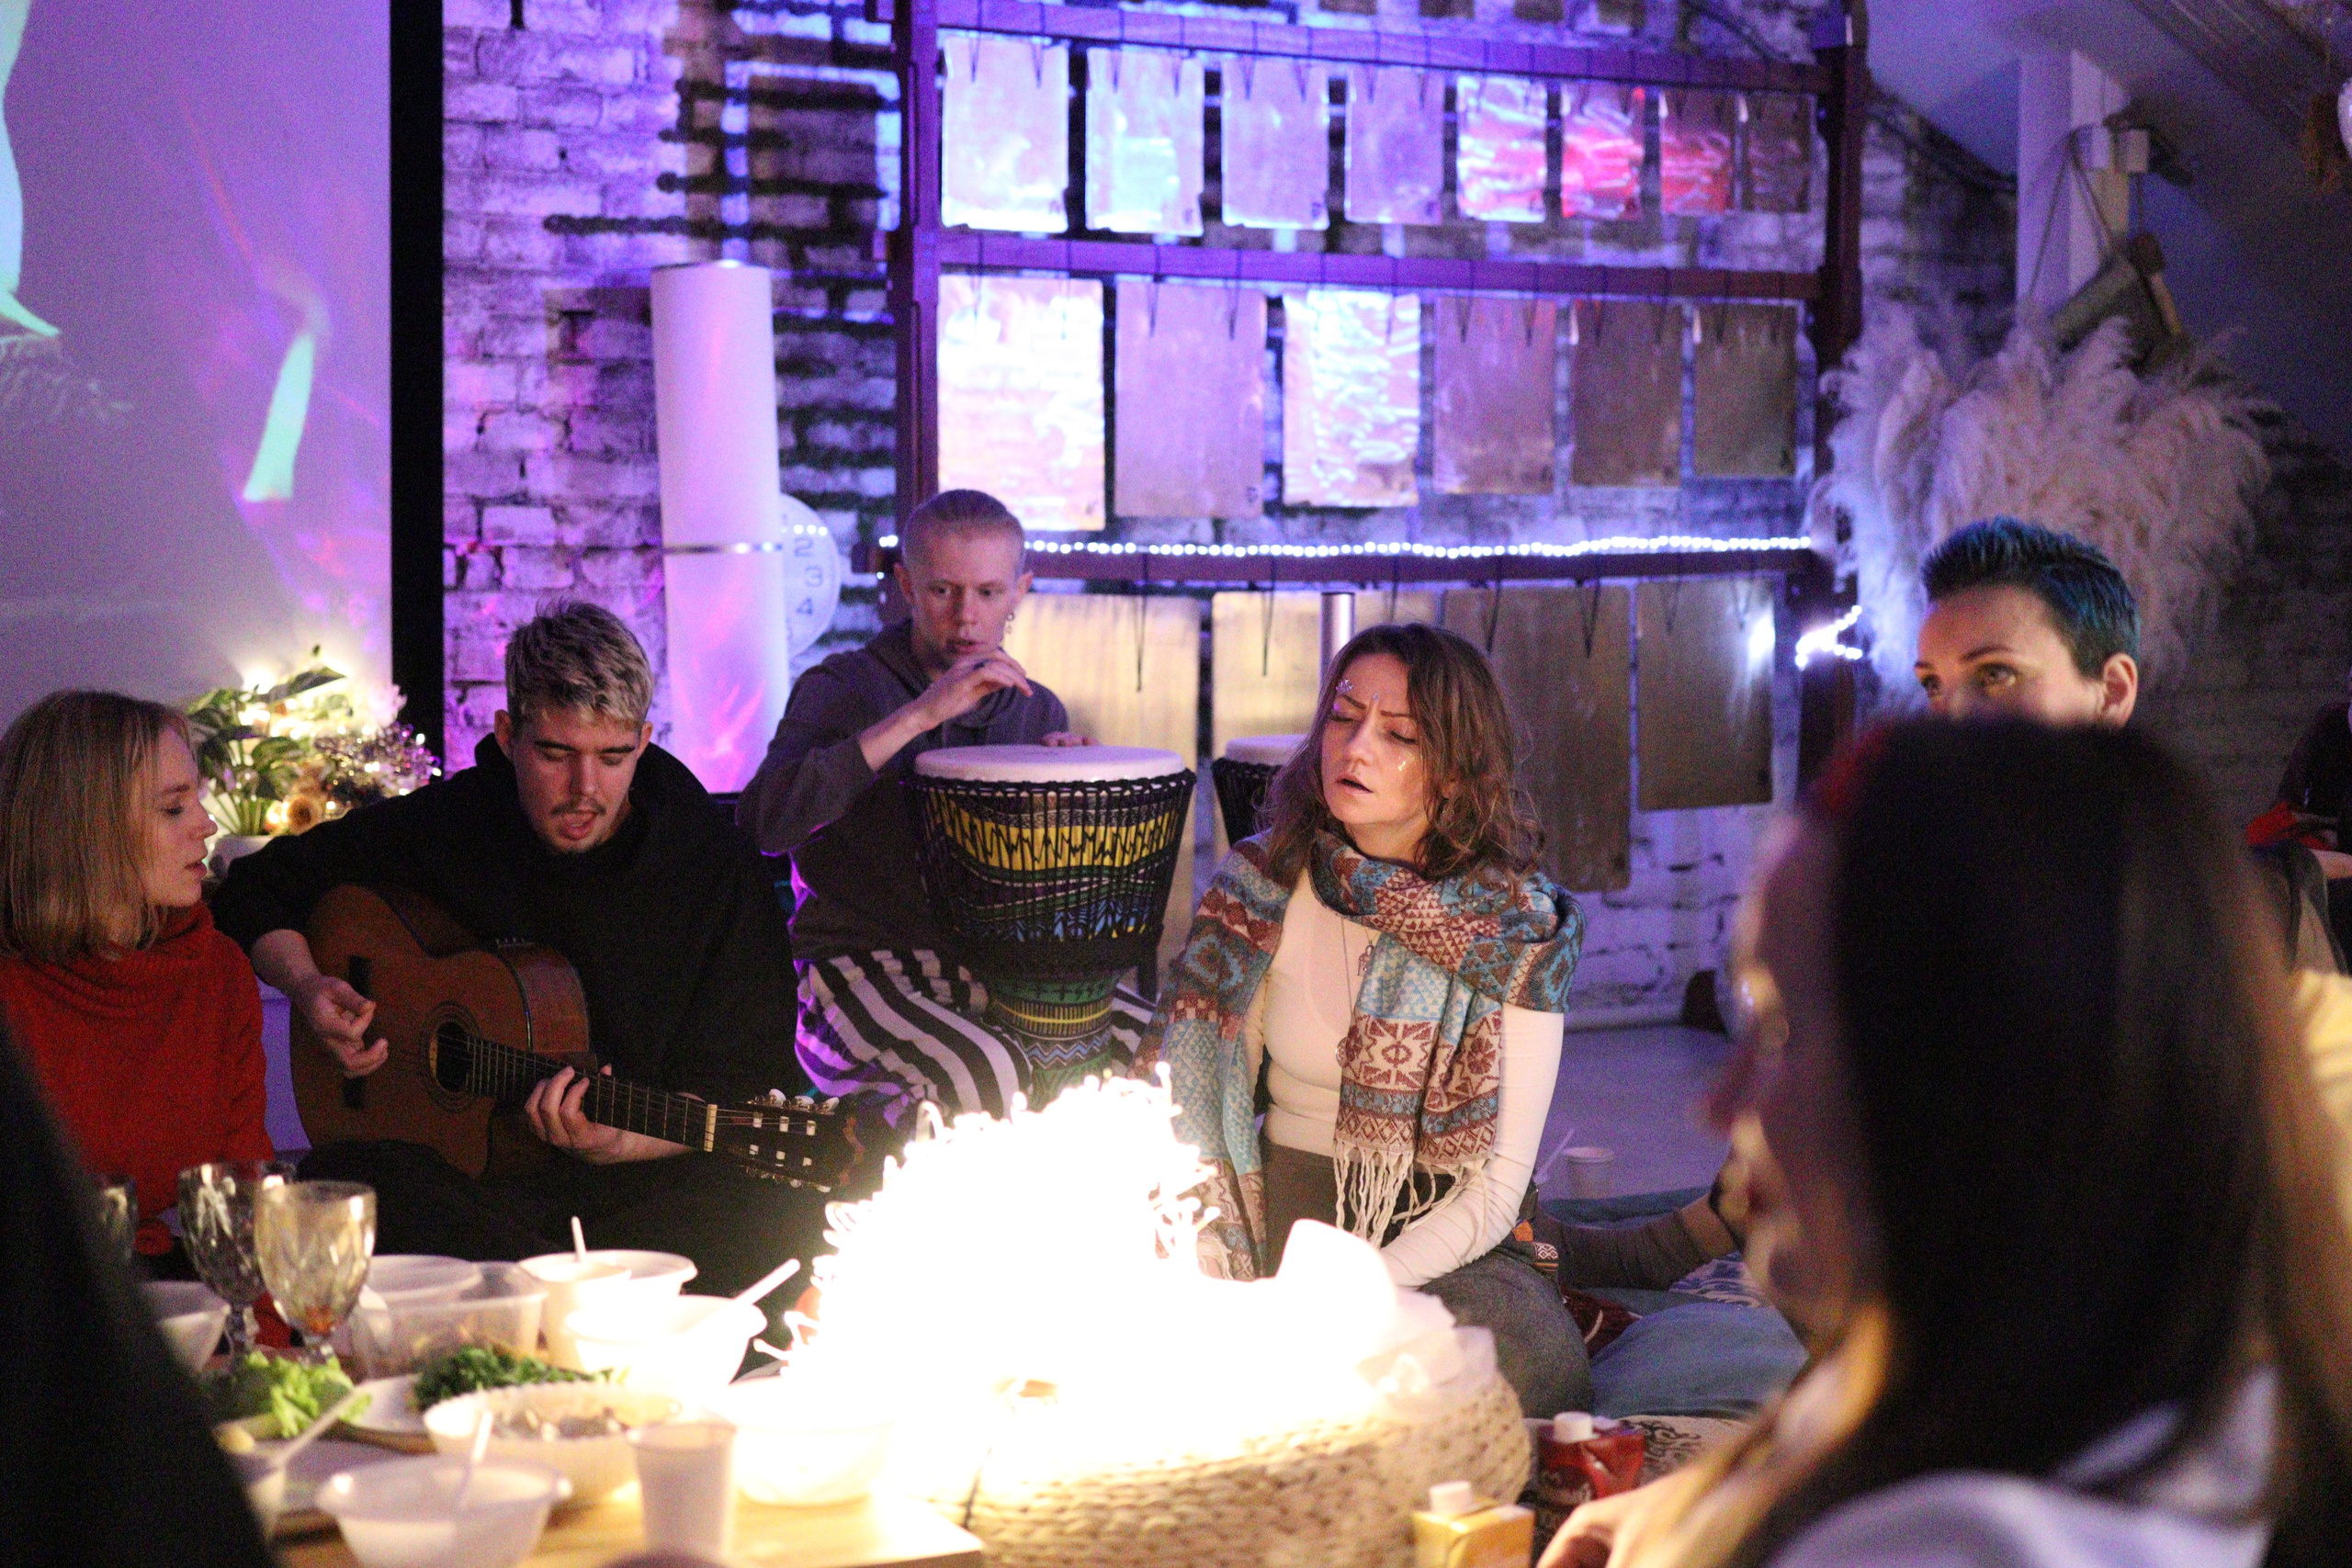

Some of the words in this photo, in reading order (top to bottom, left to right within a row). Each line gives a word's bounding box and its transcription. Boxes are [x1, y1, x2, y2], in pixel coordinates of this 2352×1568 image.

[794, 536, 815, 558] 2
[803, 564, 824, 588] 3
[796, 597, 813, 615] 4
